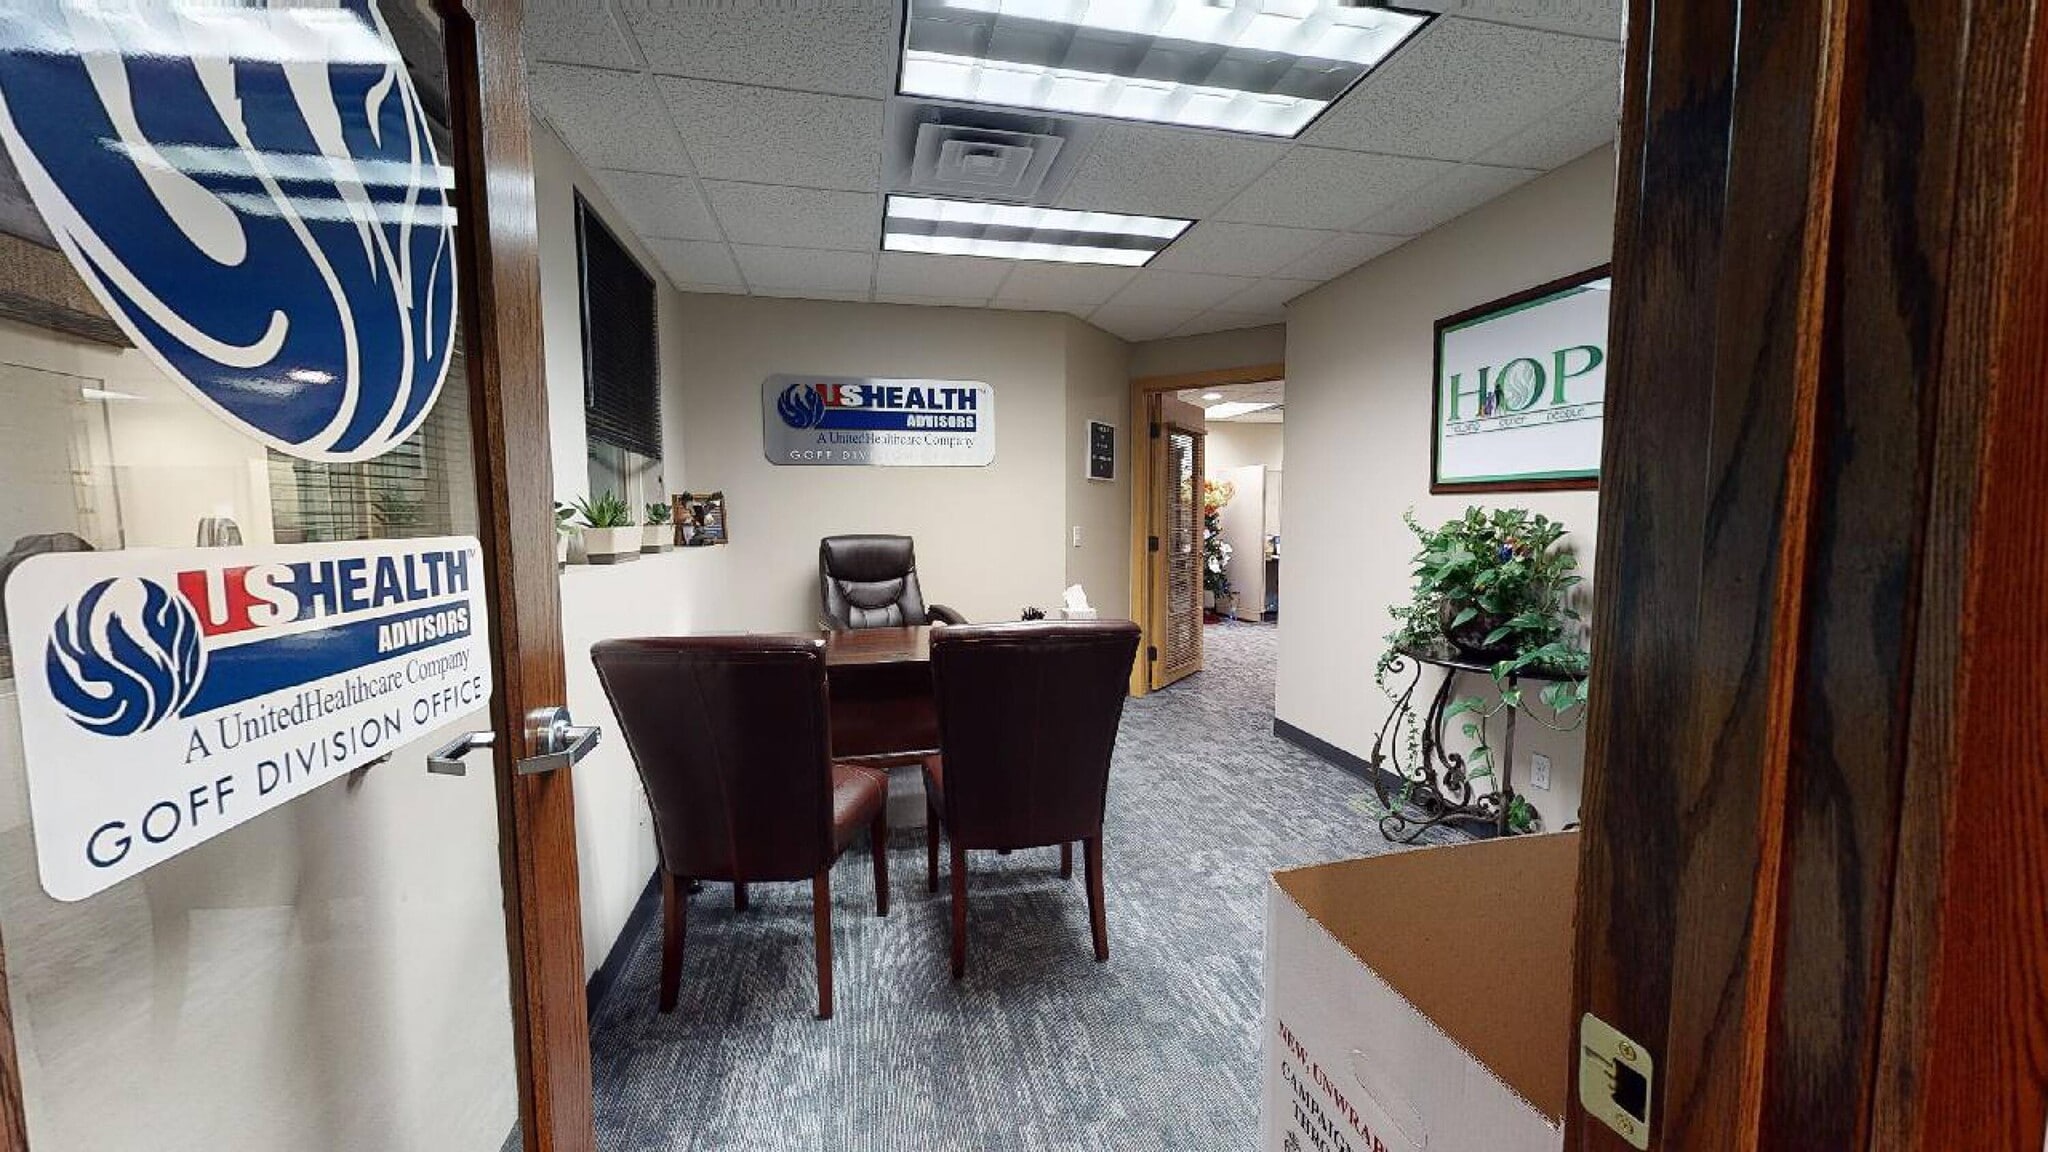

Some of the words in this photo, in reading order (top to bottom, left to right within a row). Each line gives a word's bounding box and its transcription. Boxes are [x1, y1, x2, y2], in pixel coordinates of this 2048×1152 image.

[817, 432, 827, 444] A
[924, 434, 975, 448] Company
[907, 415, 974, 428] ADVISORS
[789, 450, 832, 460] GOFF
[377, 607, 469, 654] ADVISORS
[184, 728, 213, 764] A
[216, 670, 403, 750] UnitedHealthcare
[406, 648, 470, 686] Company
[86, 776, 235, 868] GOFF
[258, 712, 401, 795] DIVISION
[413, 676, 482, 724] OFFICE
[1312, 1062, 1389, 1152] UNWRAP
